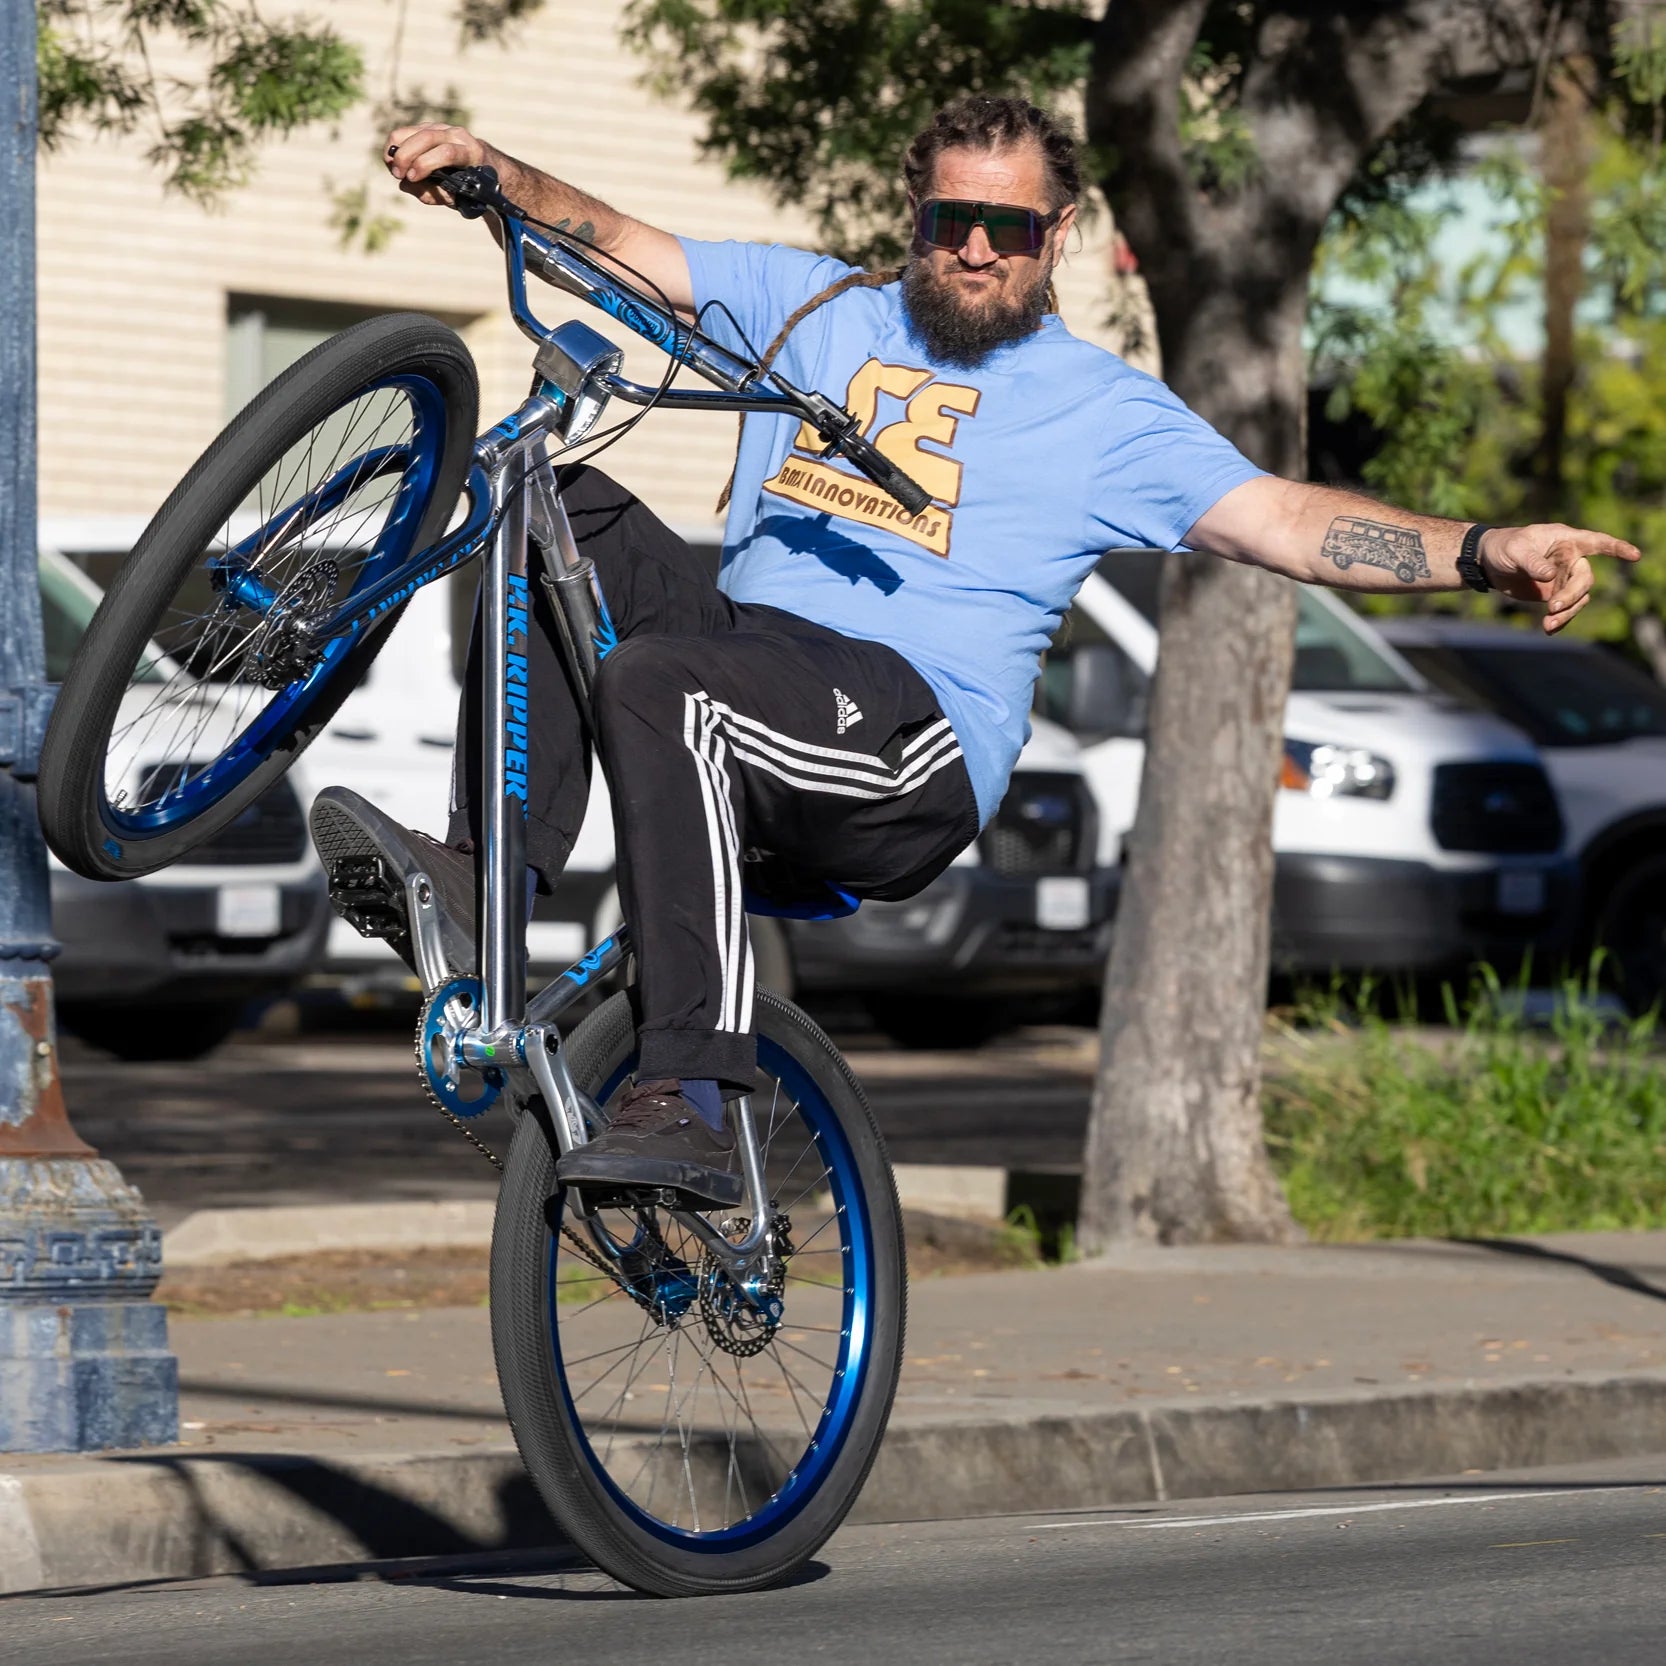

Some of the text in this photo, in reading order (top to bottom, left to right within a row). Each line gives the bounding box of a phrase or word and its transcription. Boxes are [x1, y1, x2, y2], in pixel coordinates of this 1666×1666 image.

[778, 466, 806, 488] BMX
[504, 651, 528, 801] RIPPER
[832, 688, 848, 735] adidas
